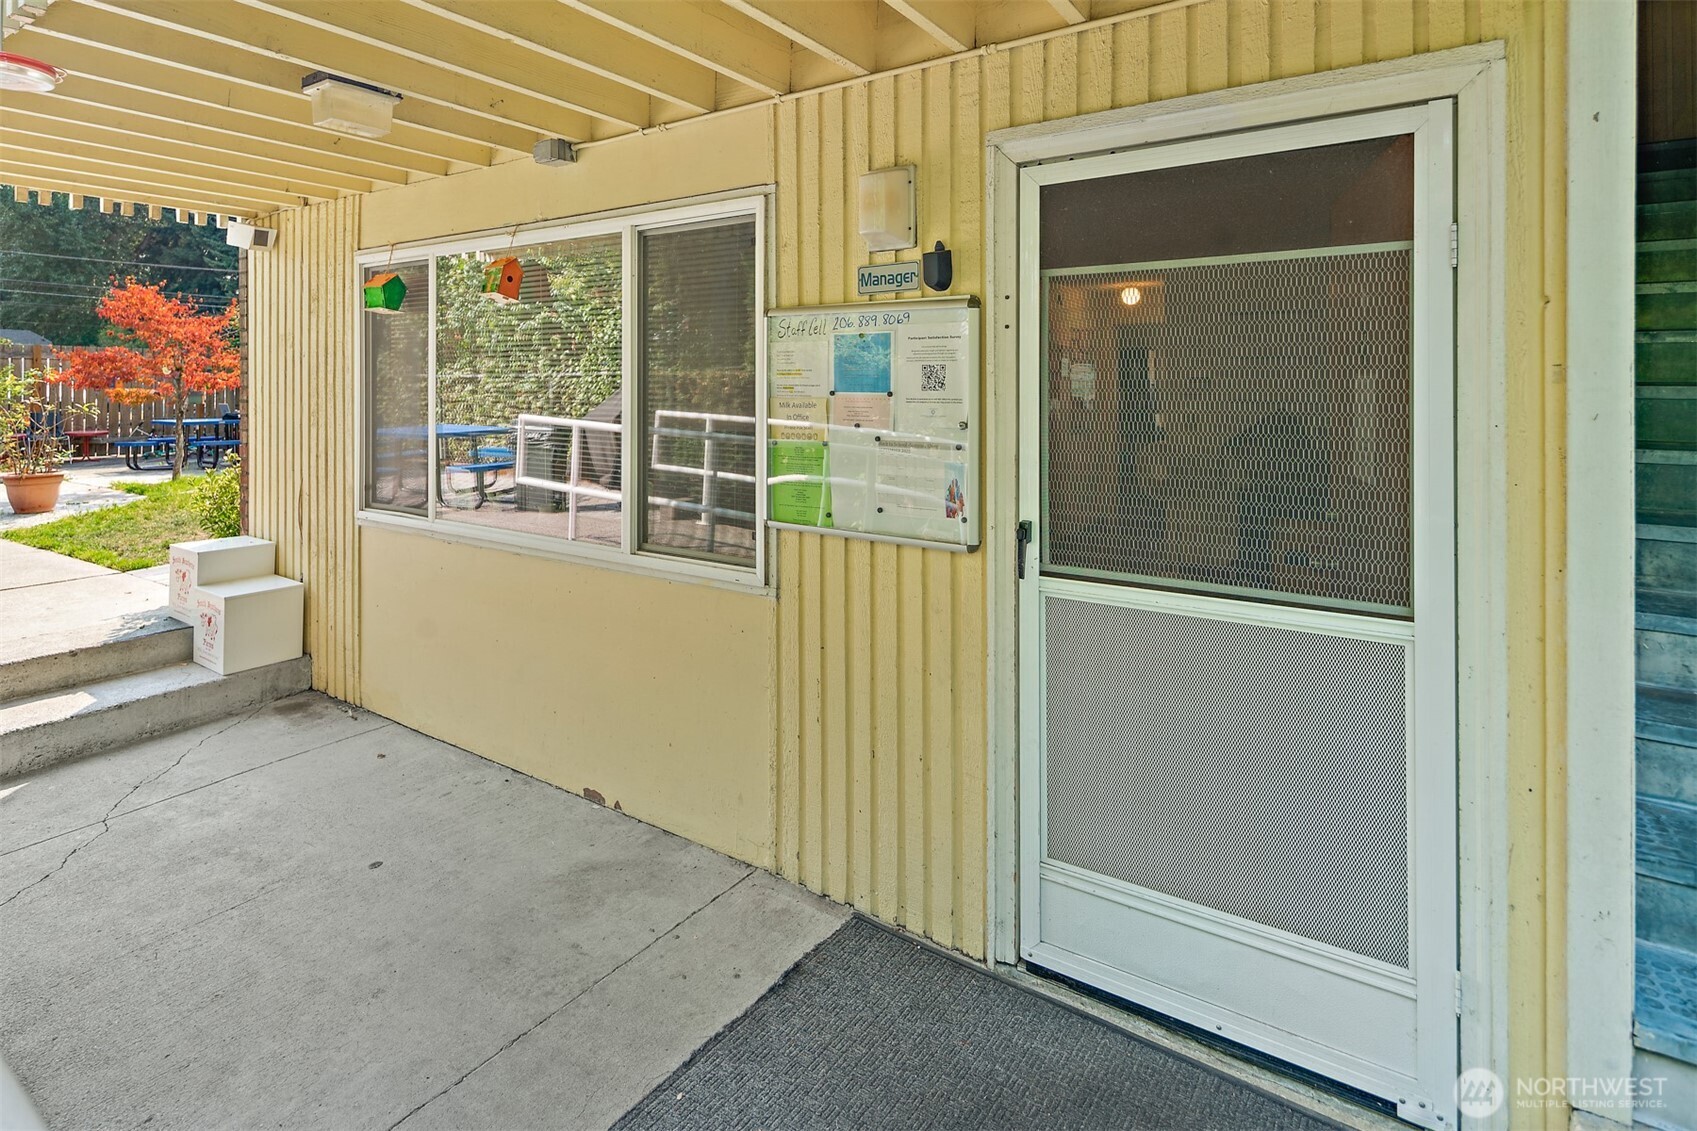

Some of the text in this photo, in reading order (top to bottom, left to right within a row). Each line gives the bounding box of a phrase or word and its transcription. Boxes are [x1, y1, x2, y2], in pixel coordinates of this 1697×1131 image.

[861, 271, 916, 288] Manager
[777, 311, 911, 338] Staff Cell 206.889.8069
[779, 401, 817, 409] Milk Available
[793, 413, 810, 421] Office
